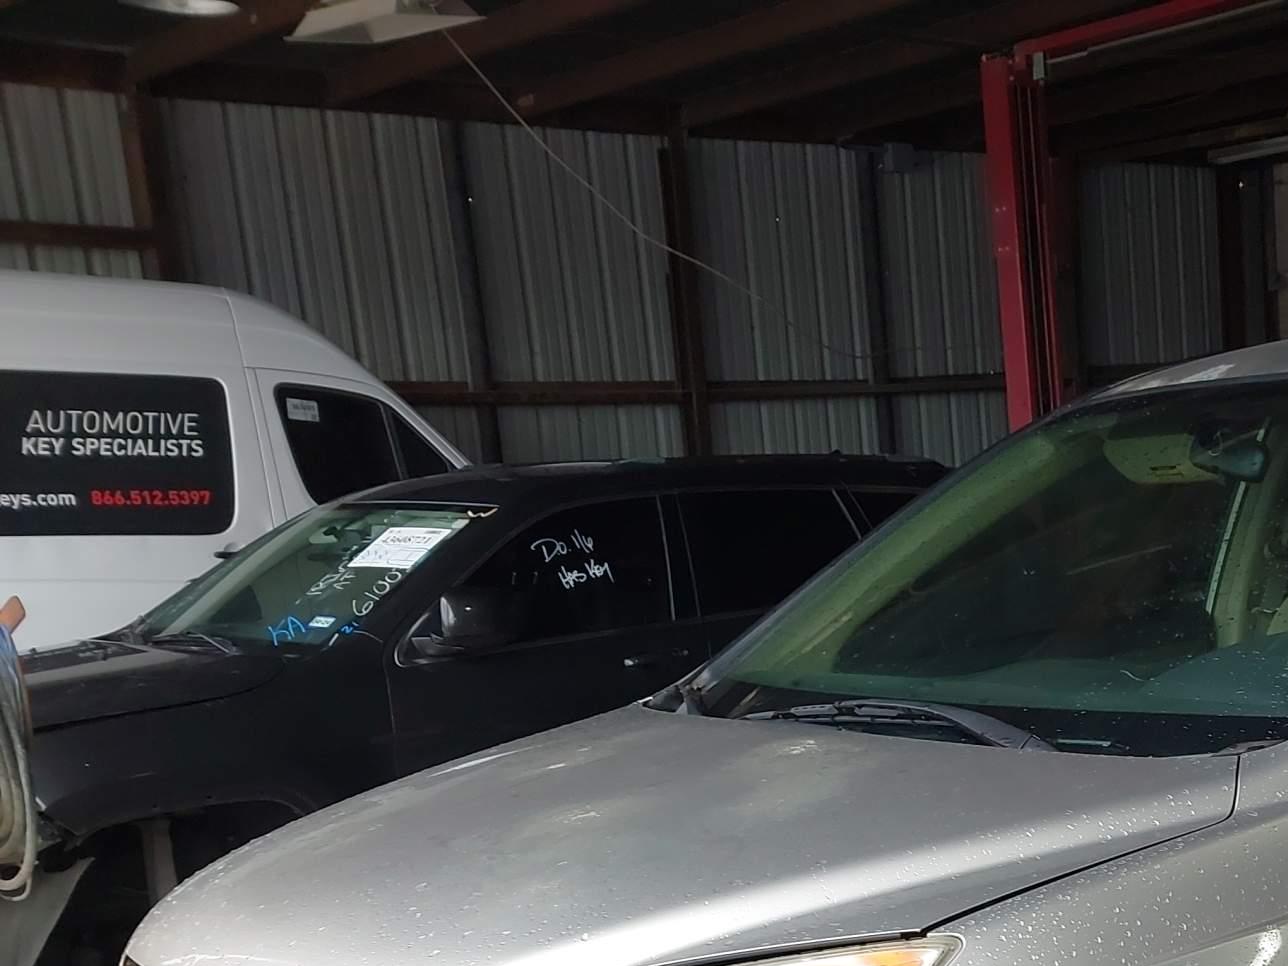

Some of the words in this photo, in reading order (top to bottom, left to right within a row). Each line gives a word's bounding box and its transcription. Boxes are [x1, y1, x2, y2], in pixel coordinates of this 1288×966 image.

[25, 409, 200, 436] AUTOMOTIVE
[21, 436, 65, 455] KEY
[71, 438, 204, 457] SPECIALISTS
[0, 493, 77, 509] eys.com
[90, 489, 211, 506] 866.512.5397
